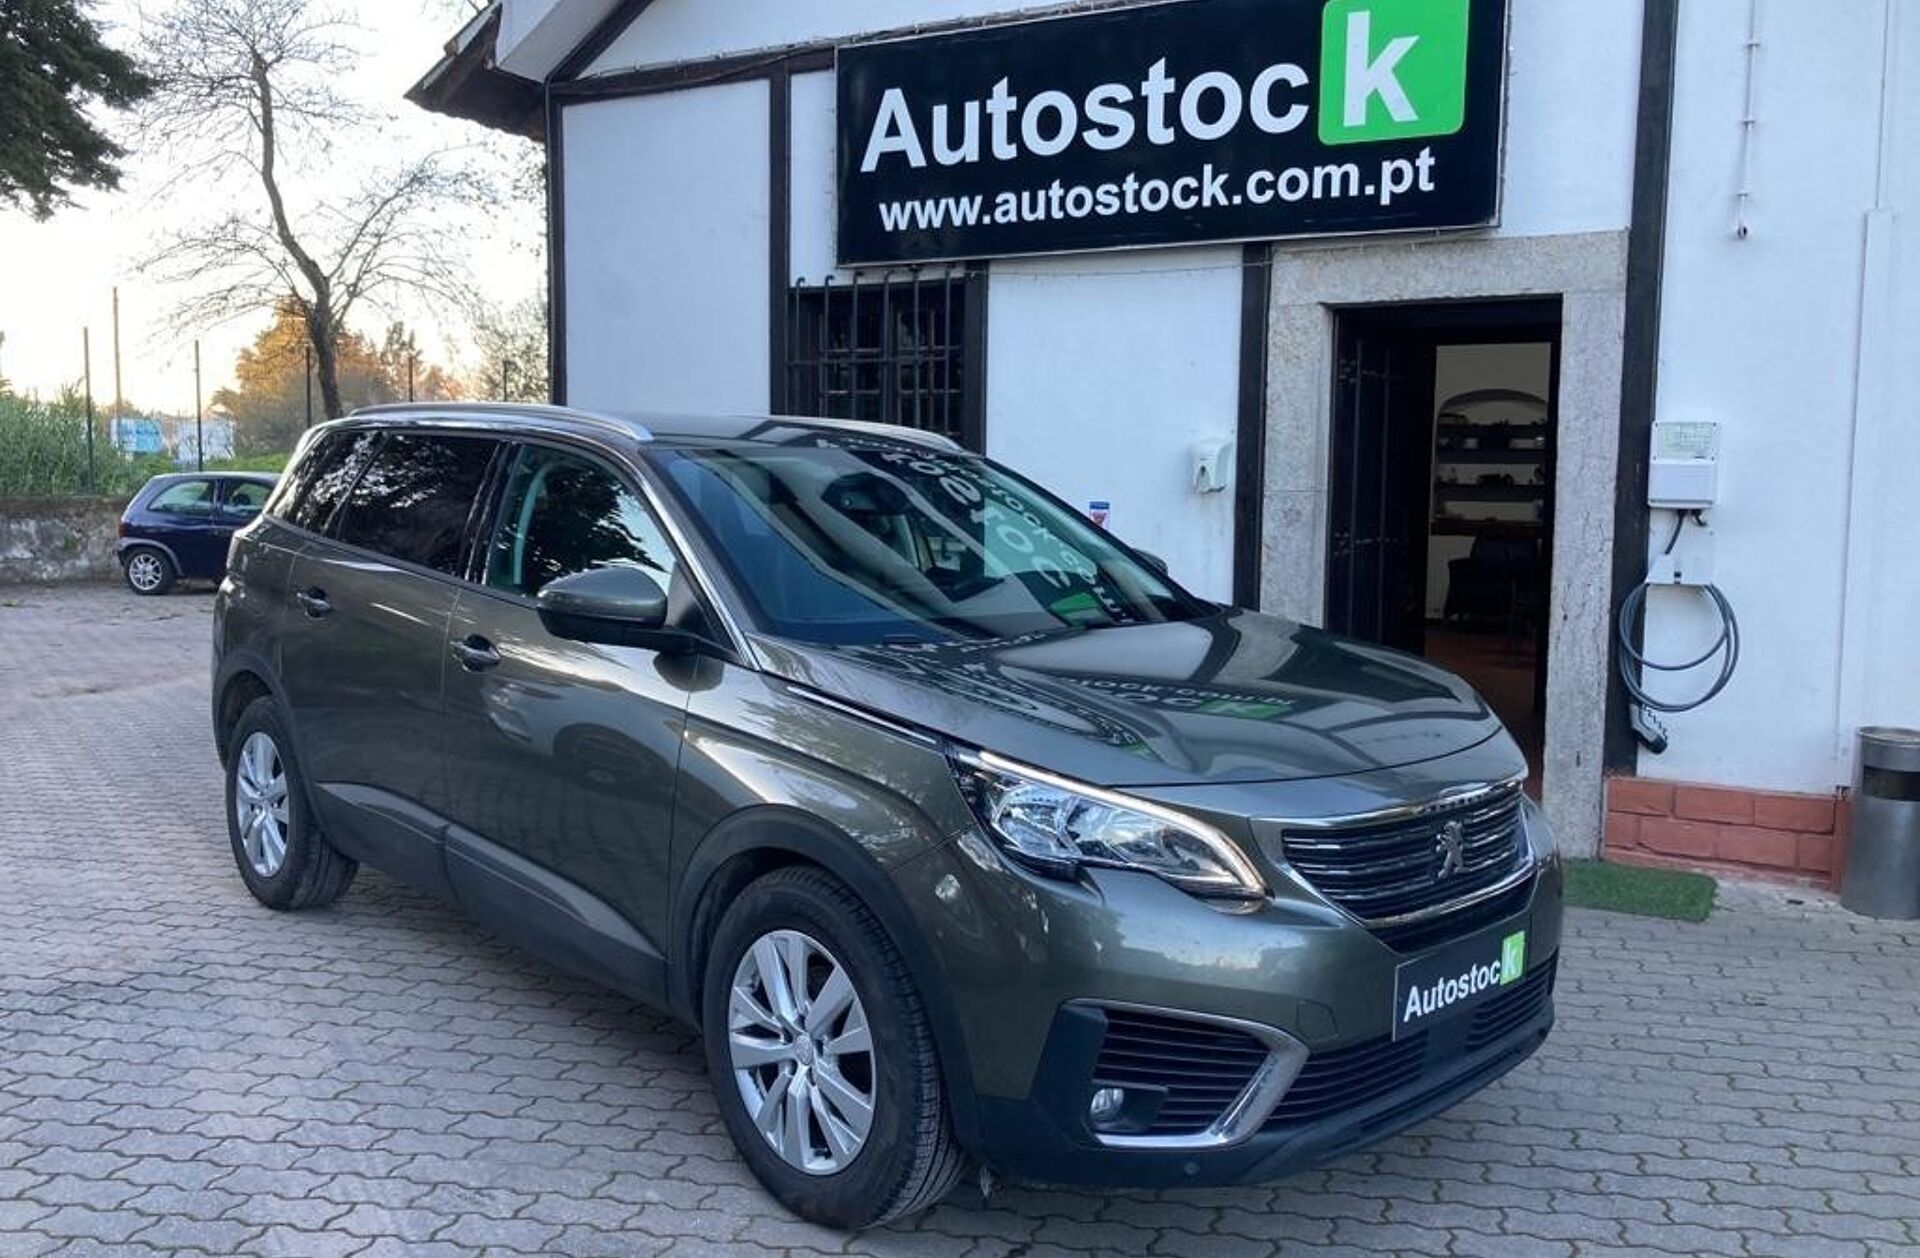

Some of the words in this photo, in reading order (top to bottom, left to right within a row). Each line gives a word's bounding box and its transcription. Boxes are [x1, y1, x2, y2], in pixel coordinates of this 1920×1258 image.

[860, 10, 1421, 173] Autostock
[879, 146, 1436, 232] www.autostock.com.pt
[1403, 939, 1517, 1022] Autostock
